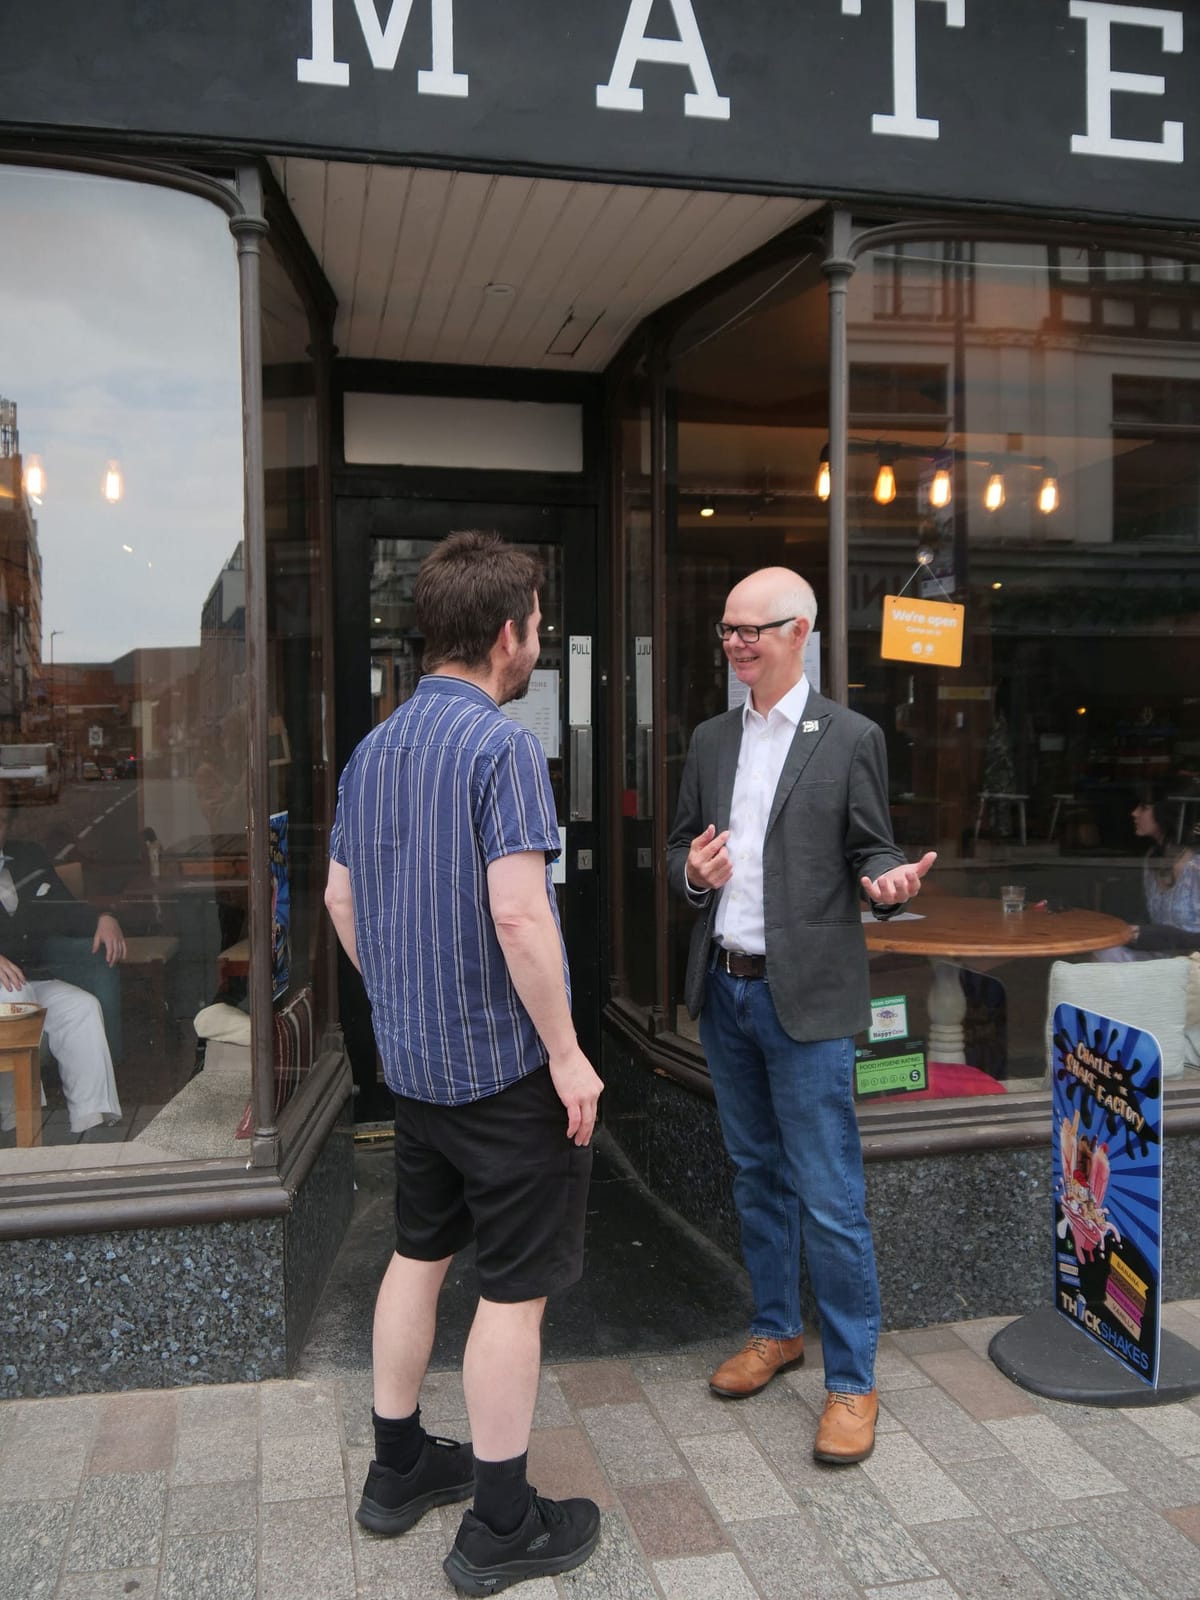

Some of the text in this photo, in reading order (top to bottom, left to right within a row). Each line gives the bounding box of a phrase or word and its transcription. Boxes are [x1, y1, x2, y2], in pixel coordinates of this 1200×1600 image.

[297, 0, 1184, 163] MATE
[928, 615, 958, 627] open
[571, 643, 590, 655] PULL
